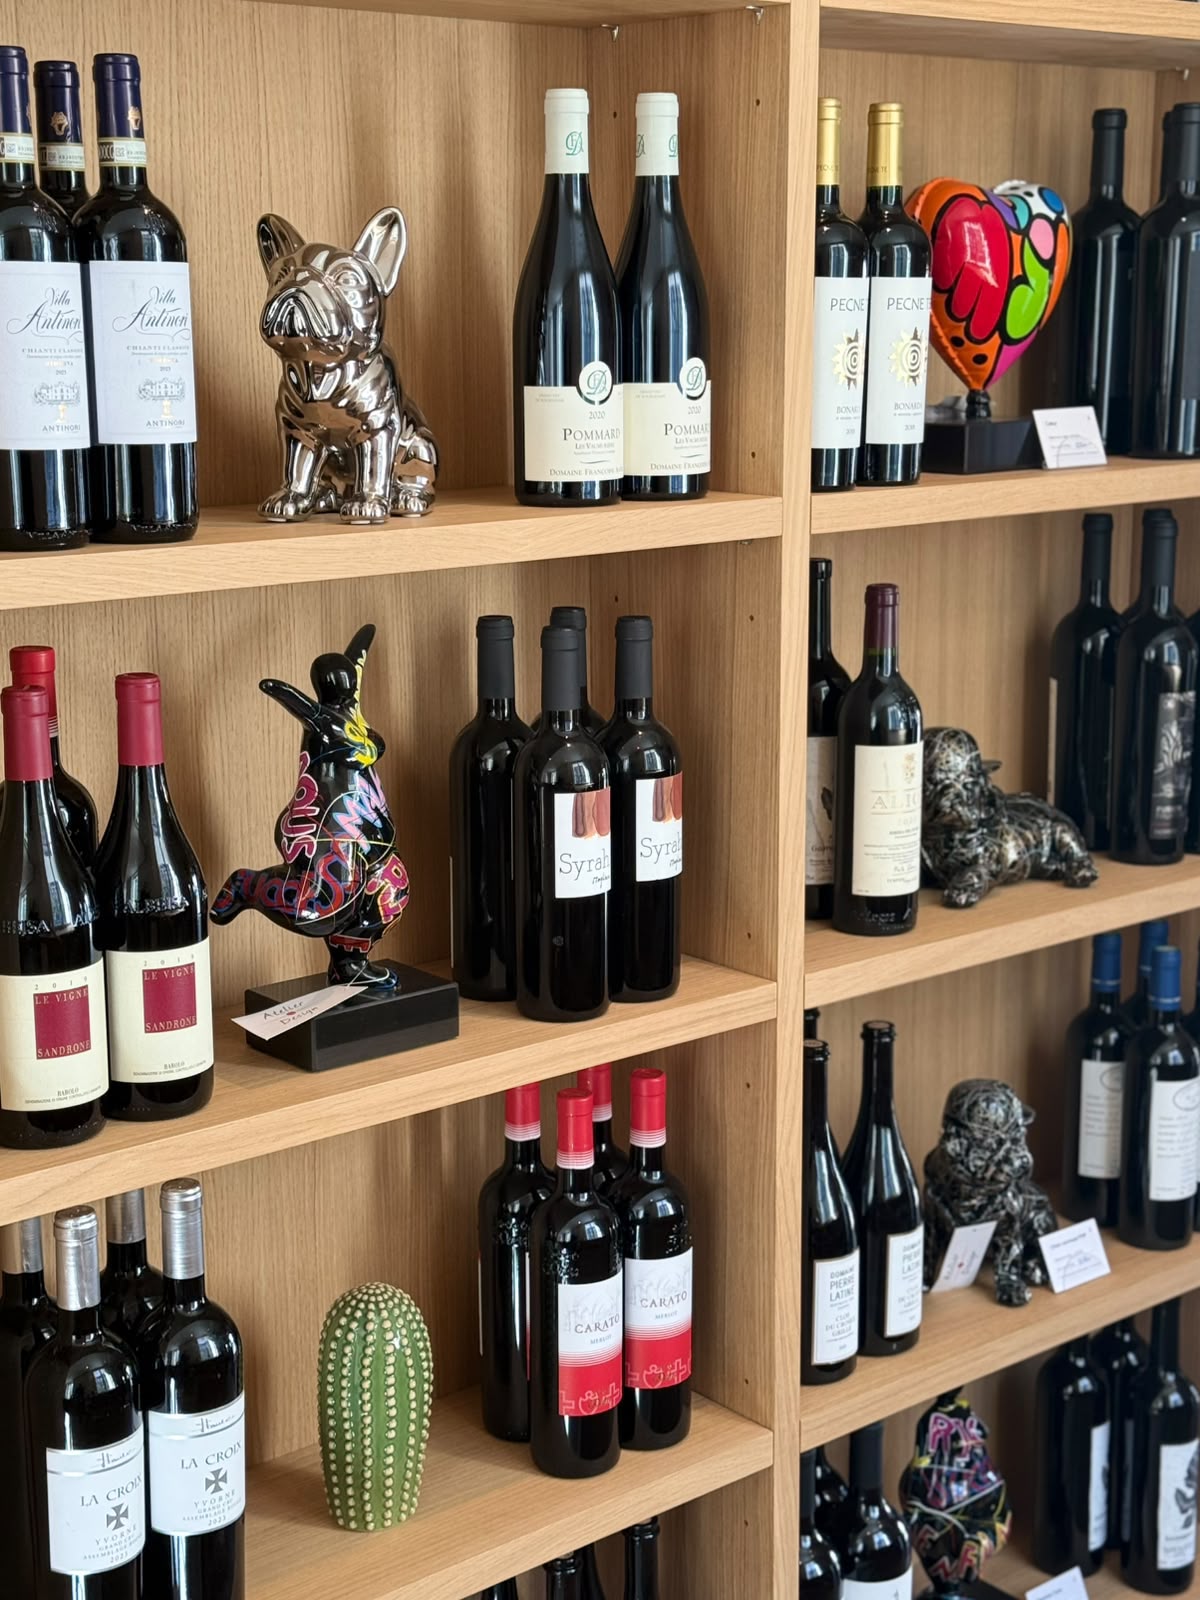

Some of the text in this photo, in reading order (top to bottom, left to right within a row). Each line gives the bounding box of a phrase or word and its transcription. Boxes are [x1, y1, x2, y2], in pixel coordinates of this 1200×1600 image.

[45, 287, 71, 306] Villa
[149, 286, 177, 305] Villa
[42, 424, 81, 432] ANTINORI
[146, 419, 185, 428] ANTINORI
[562, 428, 621, 441] POMMARD
[549, 468, 582, 476] DOMAINE
[559, 848, 610, 881] Syrah
[144, 965, 195, 981] LE VIGNE
[35, 987, 89, 1005] LE VIGNE
[263, 1001, 304, 1021] Atelier
[280, 1006, 320, 1026] Design
[145, 1016, 197, 1032] SANDRONE
[37, 1040, 91, 1058] SANDRONE
[57, 1087, 79, 1097] BAROLO
[830, 1273, 855, 1291] PIERRE
[639, 1290, 688, 1308] CARATO
[829, 1285, 855, 1302] LATINE
[574, 1313, 620, 1334] CARATO
[655, 1310, 678, 1320] MERLOT
[590, 1333, 613, 1345] MERLOT
[180, 1440, 242, 1470] LA CROIX
[80, 1473, 143, 1508] LA CROIX
[194, 1489, 236, 1509] YVORNE
[95, 1523, 137, 1546] YVORNE
